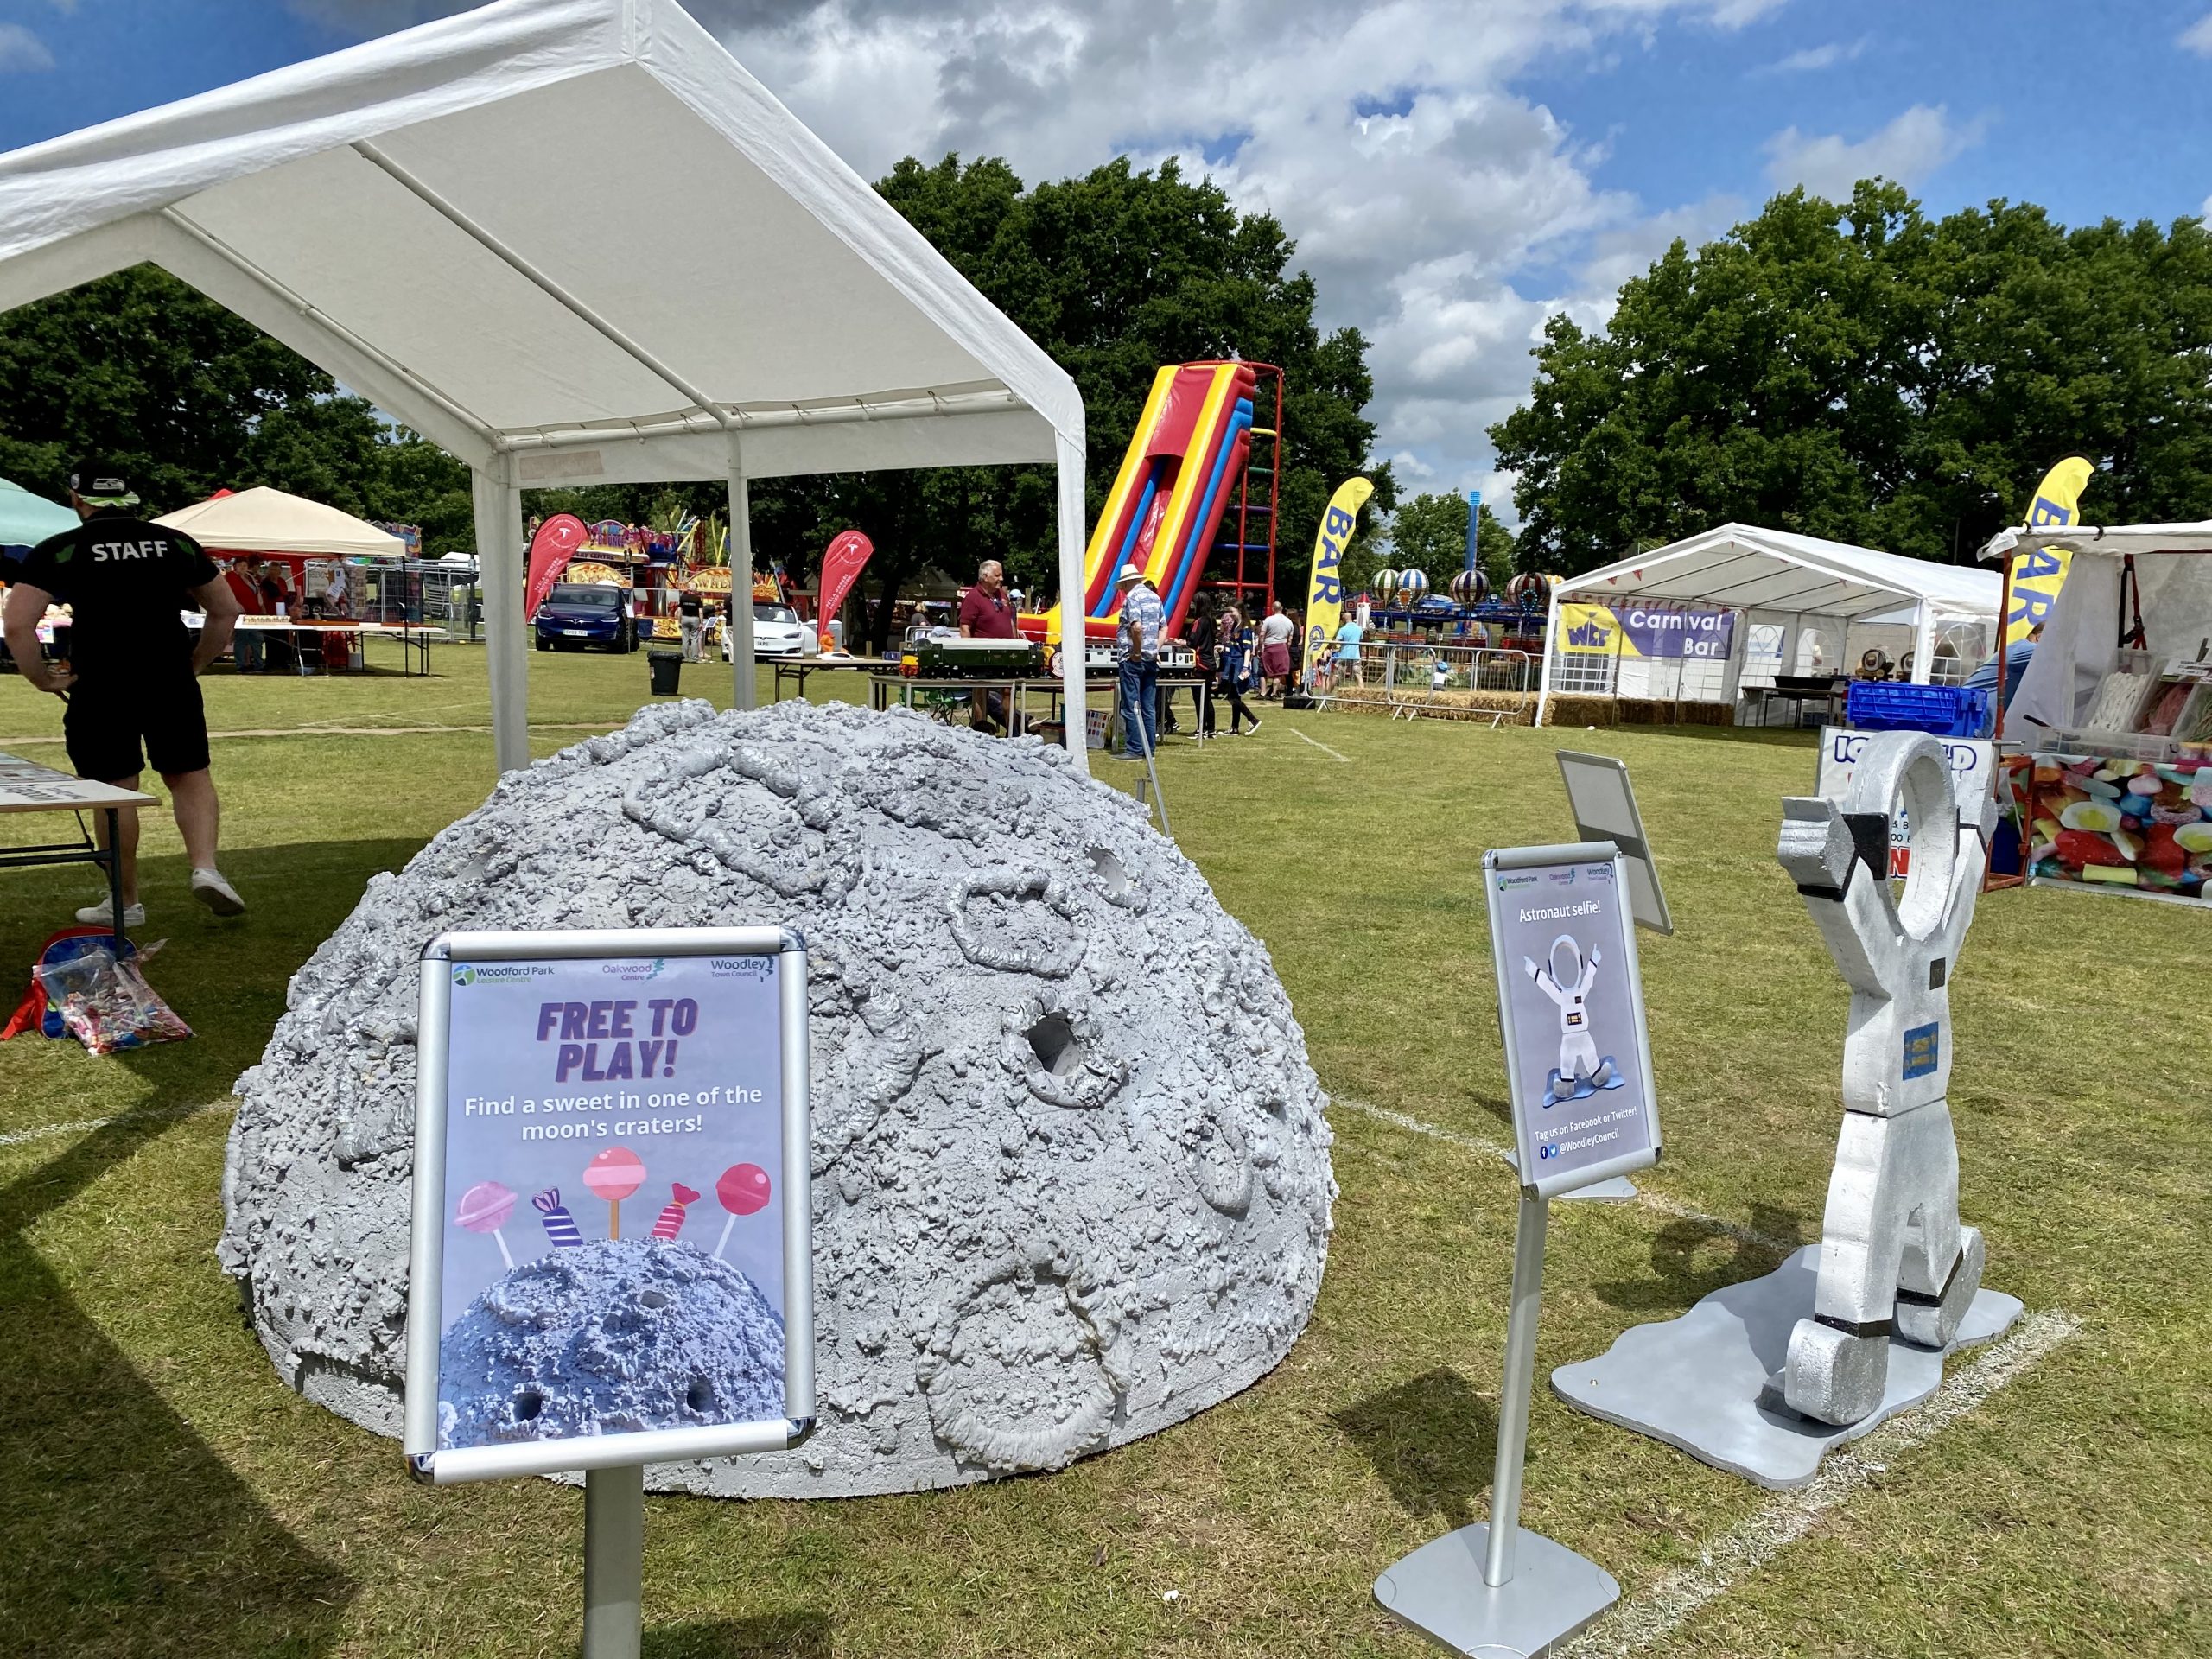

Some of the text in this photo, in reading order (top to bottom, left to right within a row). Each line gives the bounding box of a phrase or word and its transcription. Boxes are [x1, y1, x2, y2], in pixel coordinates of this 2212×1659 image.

[92, 541, 168, 562] STAFF
[1313, 505, 1355, 604] BAR
[1684, 638, 1719, 656] Bar
[1507, 875, 1529, 884] Woodford
[1587, 868, 1610, 876] Woodley
[1519, 900, 1601, 923] Astronaut selfie!
[476, 966, 556, 976] Woodford Park
[602, 963, 652, 974] Oakwood
[711, 958, 766, 970] Woodley
[537, 998, 699, 1042] FREE TO
[555, 1039, 678, 1083] PLAY!
[465, 1085, 762, 1116] Find a sweet in one of the
[522, 1114, 702, 1140] moon's craters!
[1535, 1106, 1637, 1141] Tag us on Facebook or Twitter!
[1559, 1128, 1620, 1154] @WoodleyCouncil
